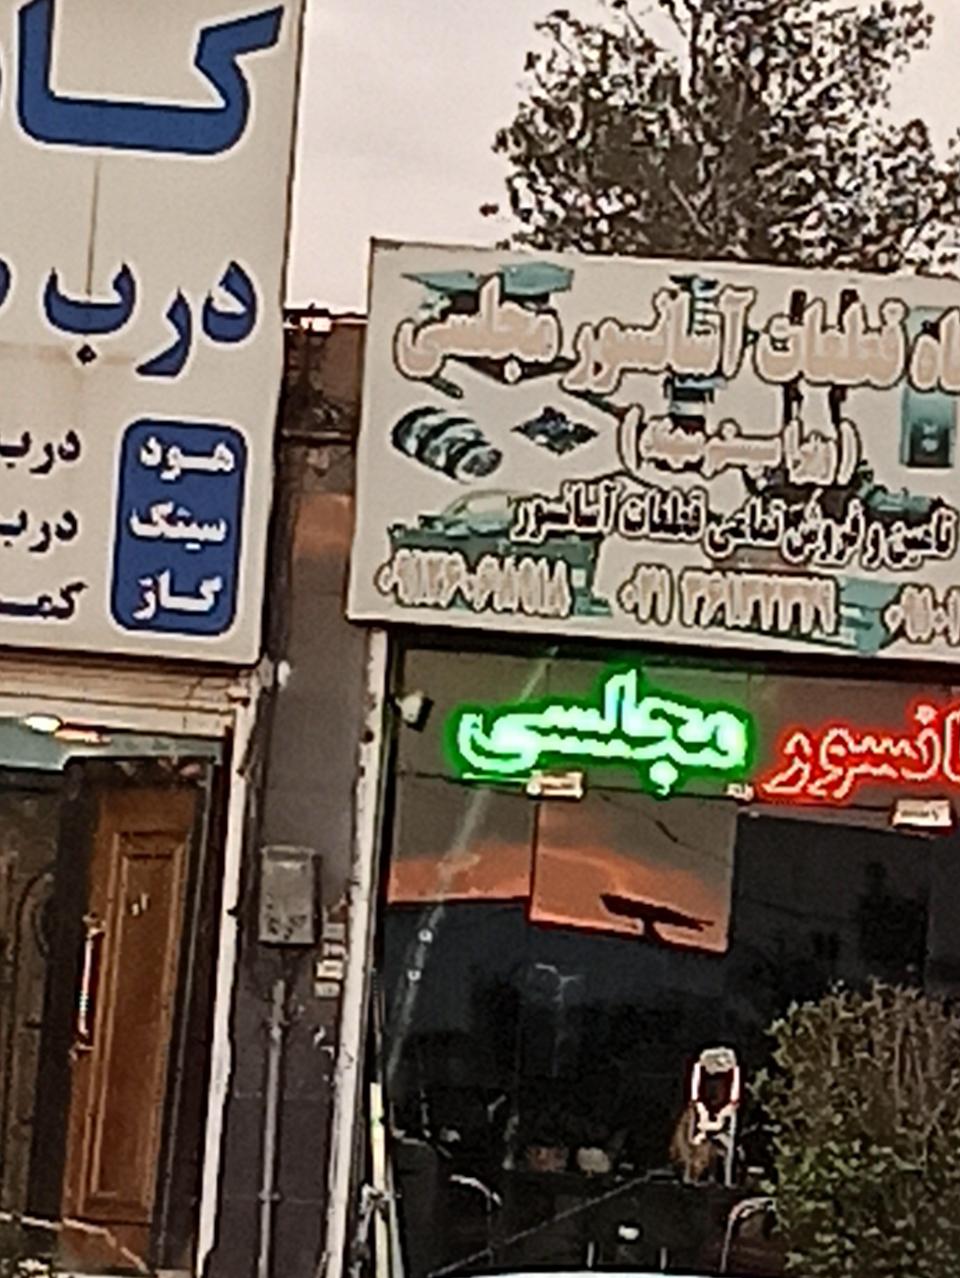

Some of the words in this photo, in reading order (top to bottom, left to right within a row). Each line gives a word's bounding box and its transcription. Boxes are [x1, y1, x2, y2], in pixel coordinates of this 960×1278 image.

[18, 0, 284, 156] کا
[44, 260, 258, 377] درب
[395, 275, 561, 382] مجلسی
[562, 286, 754, 392] آسانسور
[756, 299, 907, 387] قطعات
[140, 437, 235, 480] هود
[129, 501, 227, 551] سینک
[618, 486, 706, 541] قطعات
[782, 491, 866, 567] فروش
[863, 521, 884, 568] و
[0, 582, 88, 620] کم
[132, 569, 223, 619] گاز
